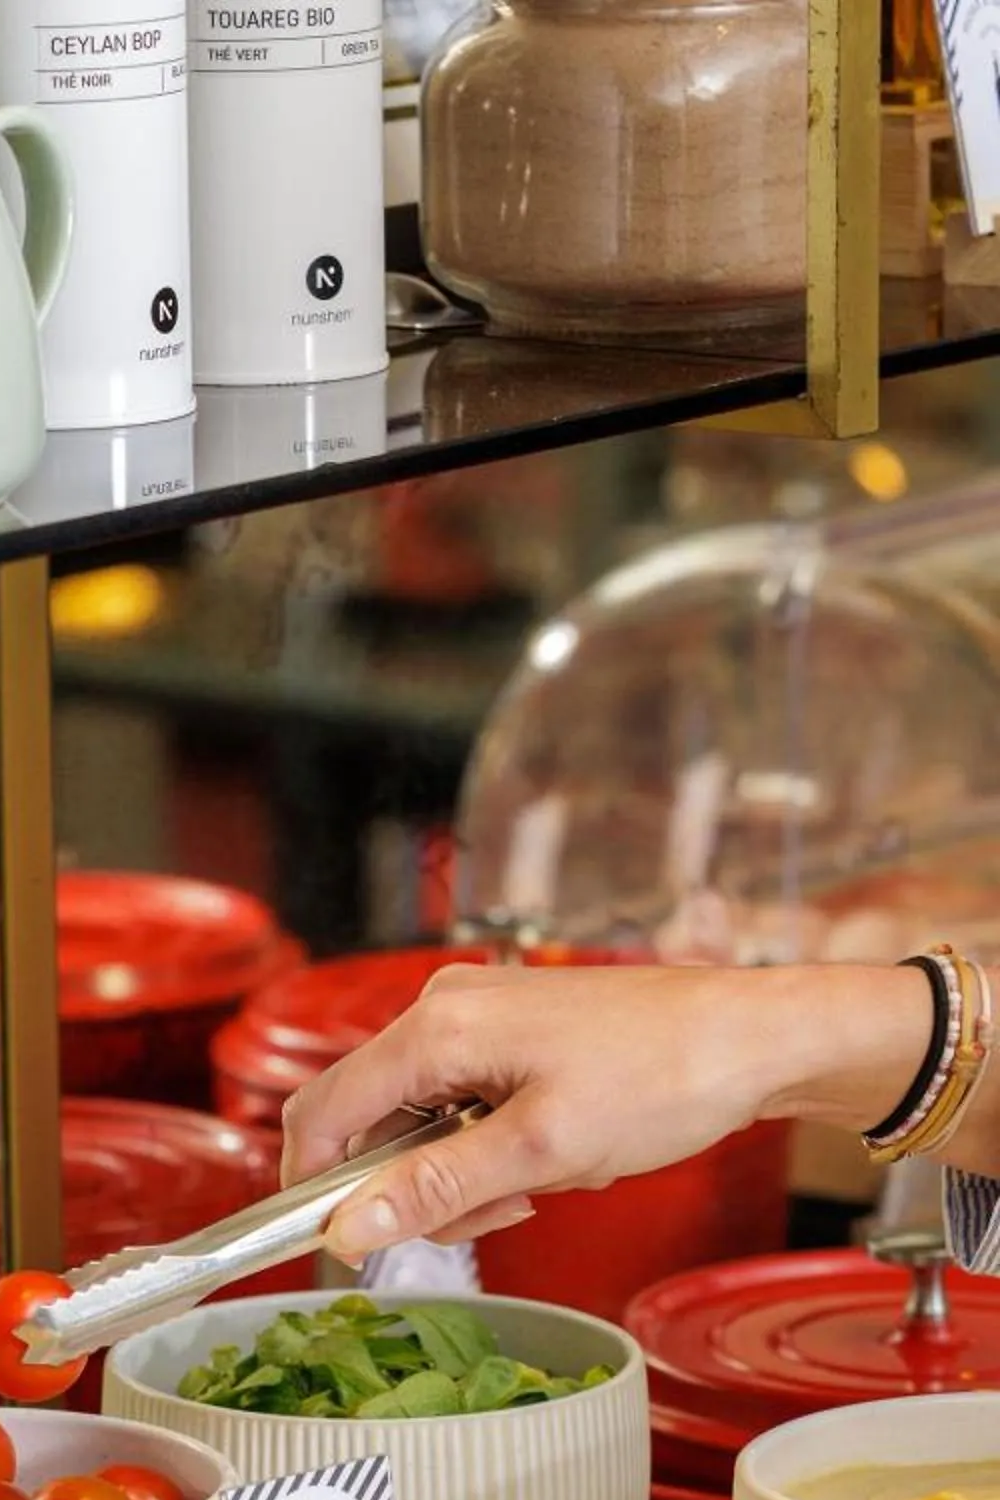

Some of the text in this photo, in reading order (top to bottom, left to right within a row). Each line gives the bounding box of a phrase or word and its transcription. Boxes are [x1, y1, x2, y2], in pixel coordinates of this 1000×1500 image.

[207, 7, 335, 29] TOUAREG BIO
[51, 29, 161, 57] CEYLAN BOP
[207, 45, 270, 62] THÉ VERT
[52, 71, 112, 88] THÉ NOIR
